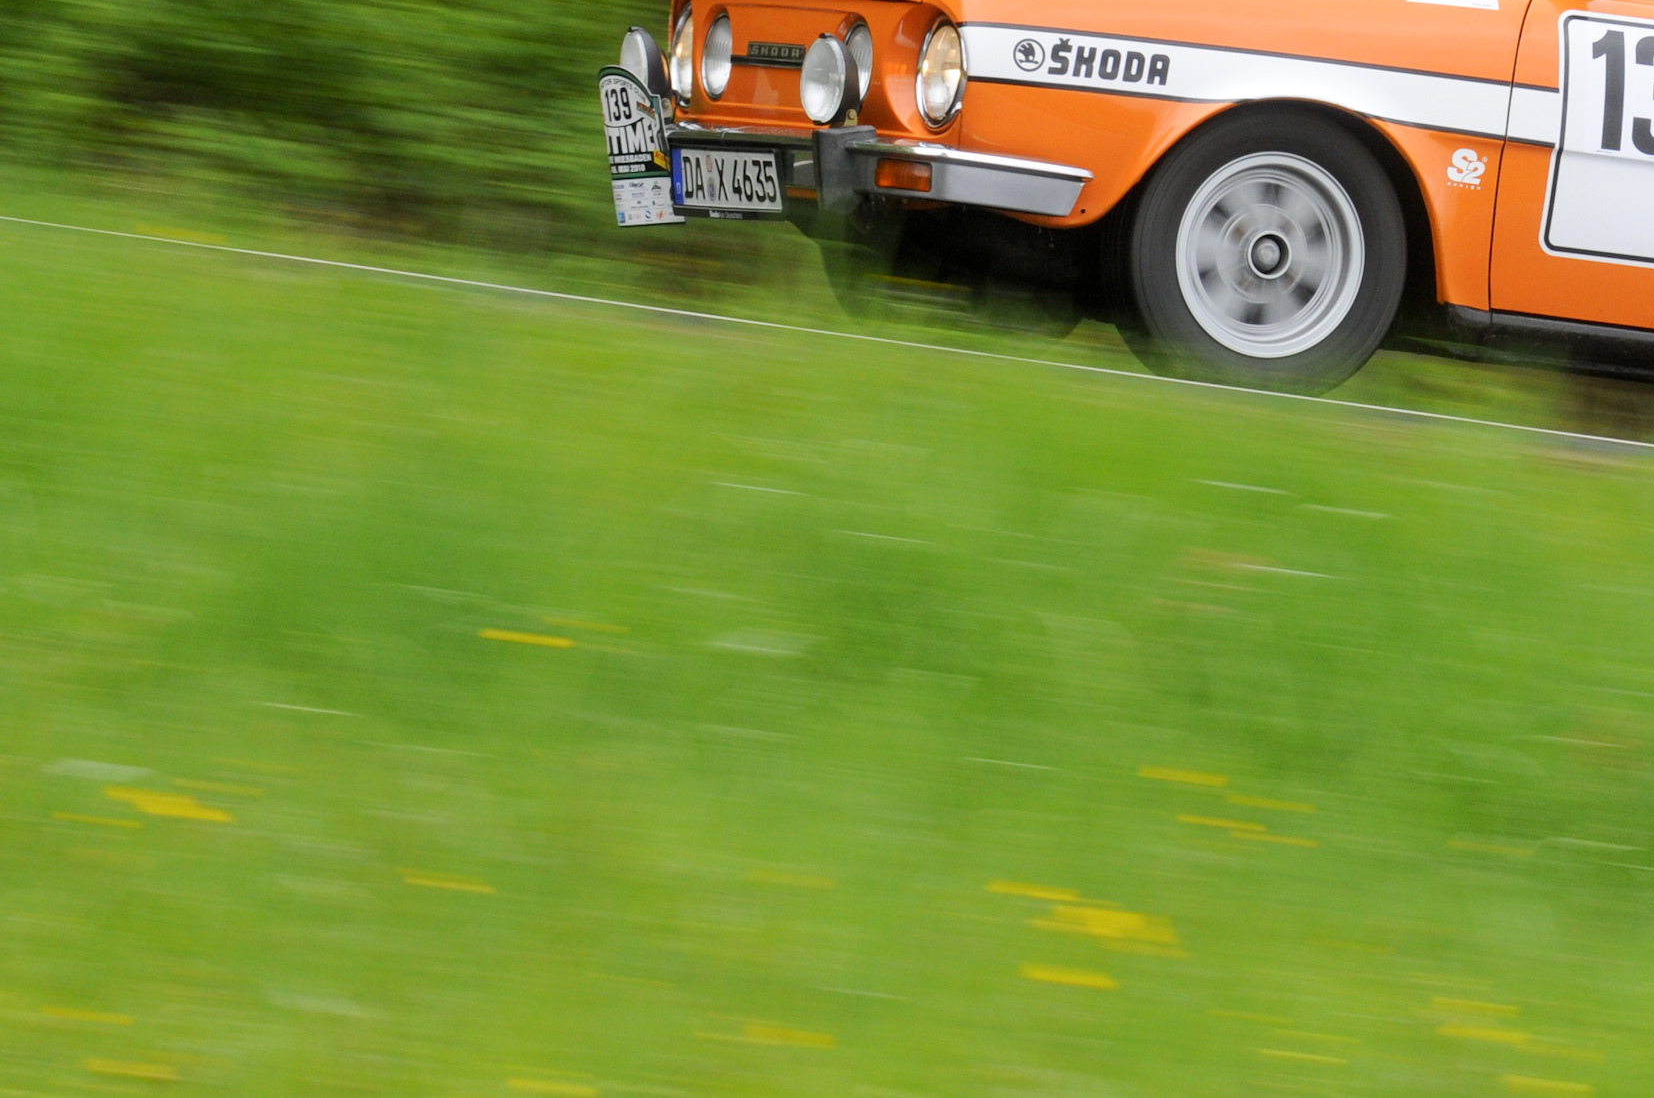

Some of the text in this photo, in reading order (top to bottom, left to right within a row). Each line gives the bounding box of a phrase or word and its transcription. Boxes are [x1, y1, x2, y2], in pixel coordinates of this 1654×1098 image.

[1047, 37, 1170, 86] ŠKODA
[605, 87, 632, 122] 139
[683, 156, 705, 199] DA
[715, 158, 728, 201] X
[732, 159, 777, 203] 4635
